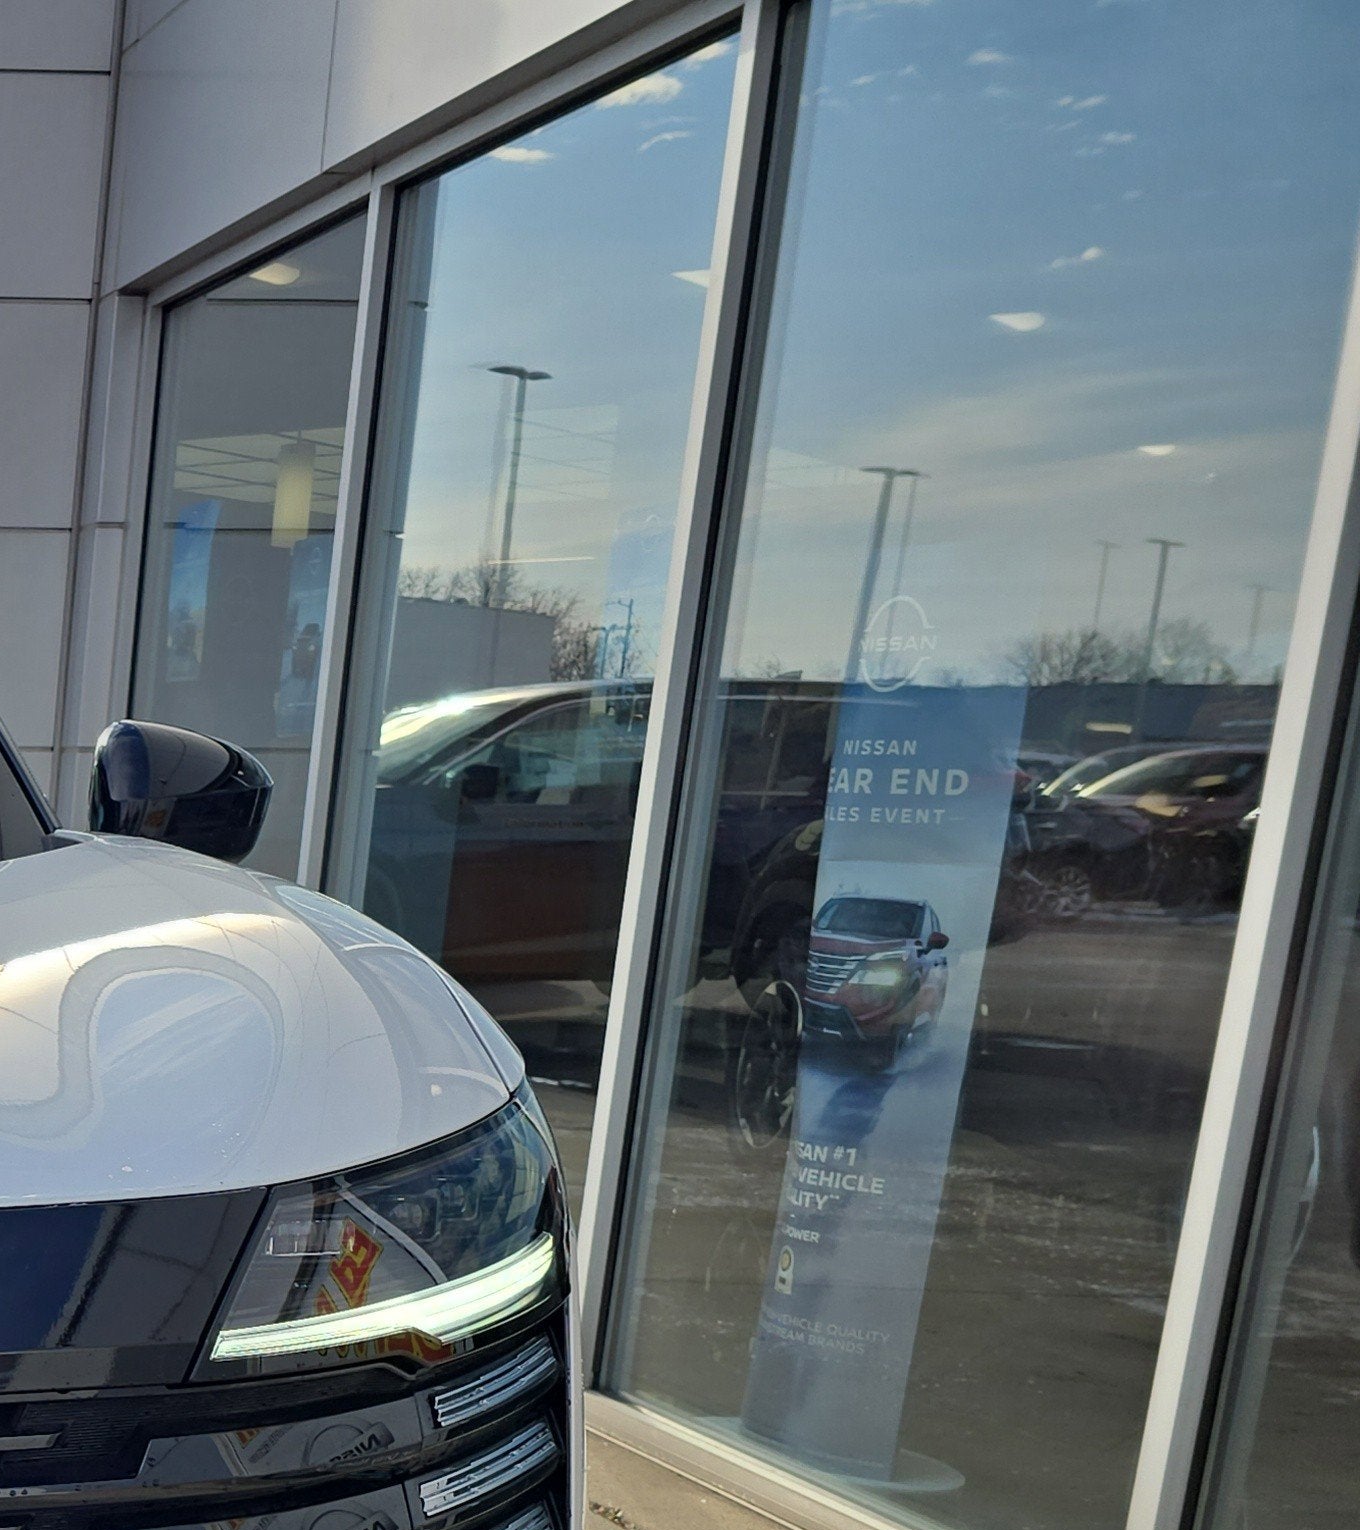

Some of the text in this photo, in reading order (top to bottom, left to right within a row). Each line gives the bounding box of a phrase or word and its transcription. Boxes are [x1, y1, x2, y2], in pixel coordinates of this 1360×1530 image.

[859, 635, 939, 652] NISSAN
[843, 740, 918, 755] NISSAN
[889, 768, 970, 795] END
[870, 807, 946, 824] EVENT
[833, 1145, 857, 1166] #1
[798, 1167, 886, 1195] VEHICLE
